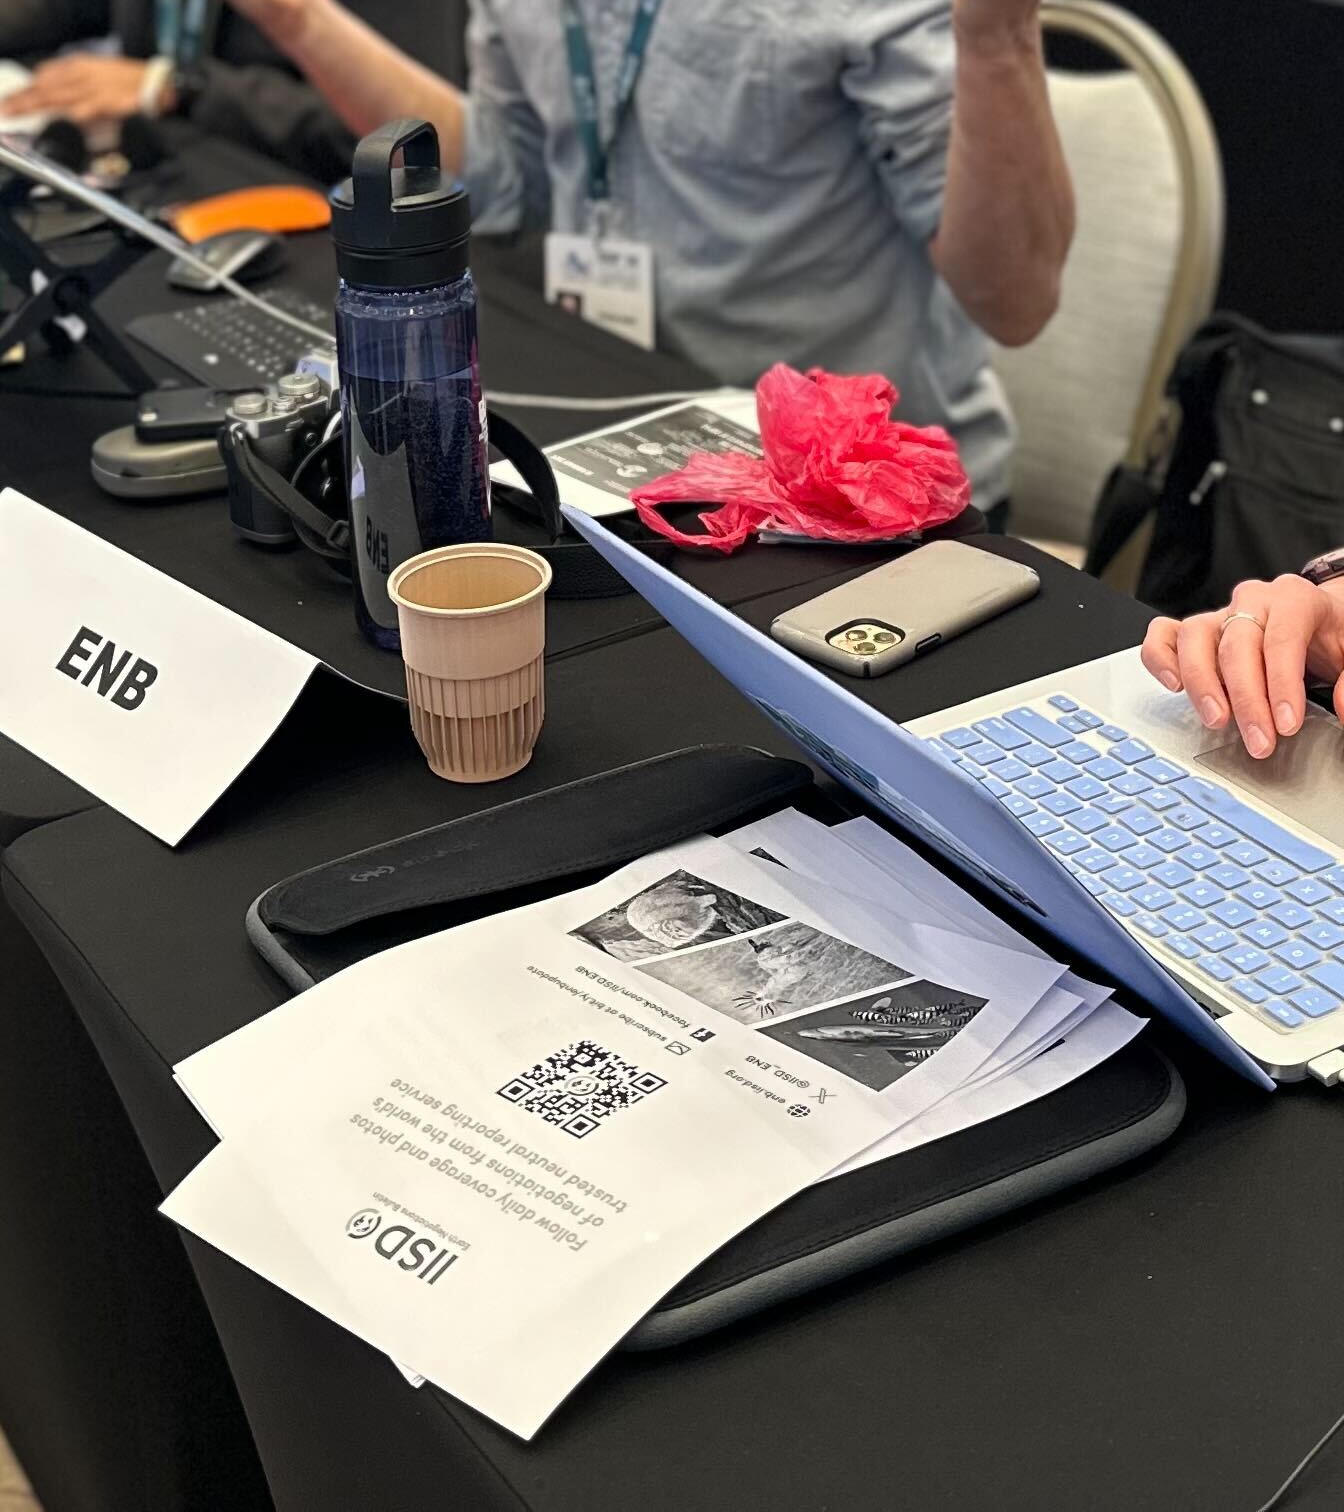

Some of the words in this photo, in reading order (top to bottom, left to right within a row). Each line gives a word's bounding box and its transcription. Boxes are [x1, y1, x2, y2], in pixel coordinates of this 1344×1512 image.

[55, 625, 159, 711] ENB
[603, 1006, 619, 1015] at
[618, 1013, 668, 1042] subscribe
[724, 1069, 786, 1104] enb.iisd.org
[744, 1055, 811, 1089] @IISD_ENB
[389, 1078, 443, 1110] service
[349, 1113, 405, 1146] photos
[421, 1123, 449, 1145] the
[439, 1103, 512, 1148] reporting
[394, 1140, 430, 1161] and
[447, 1137, 487, 1166] from
[505, 1143, 569, 1179] neutral
[428, 1156, 498, 1199] coverage
[485, 1158, 585, 1217] negotiations
[562, 1174, 628, 1214] trusted
[494, 1191, 537, 1222] daily
[576, 1213, 605, 1227] of
[533, 1216, 589, 1252] Follow
[374, 1224, 459, 1286] IISD
